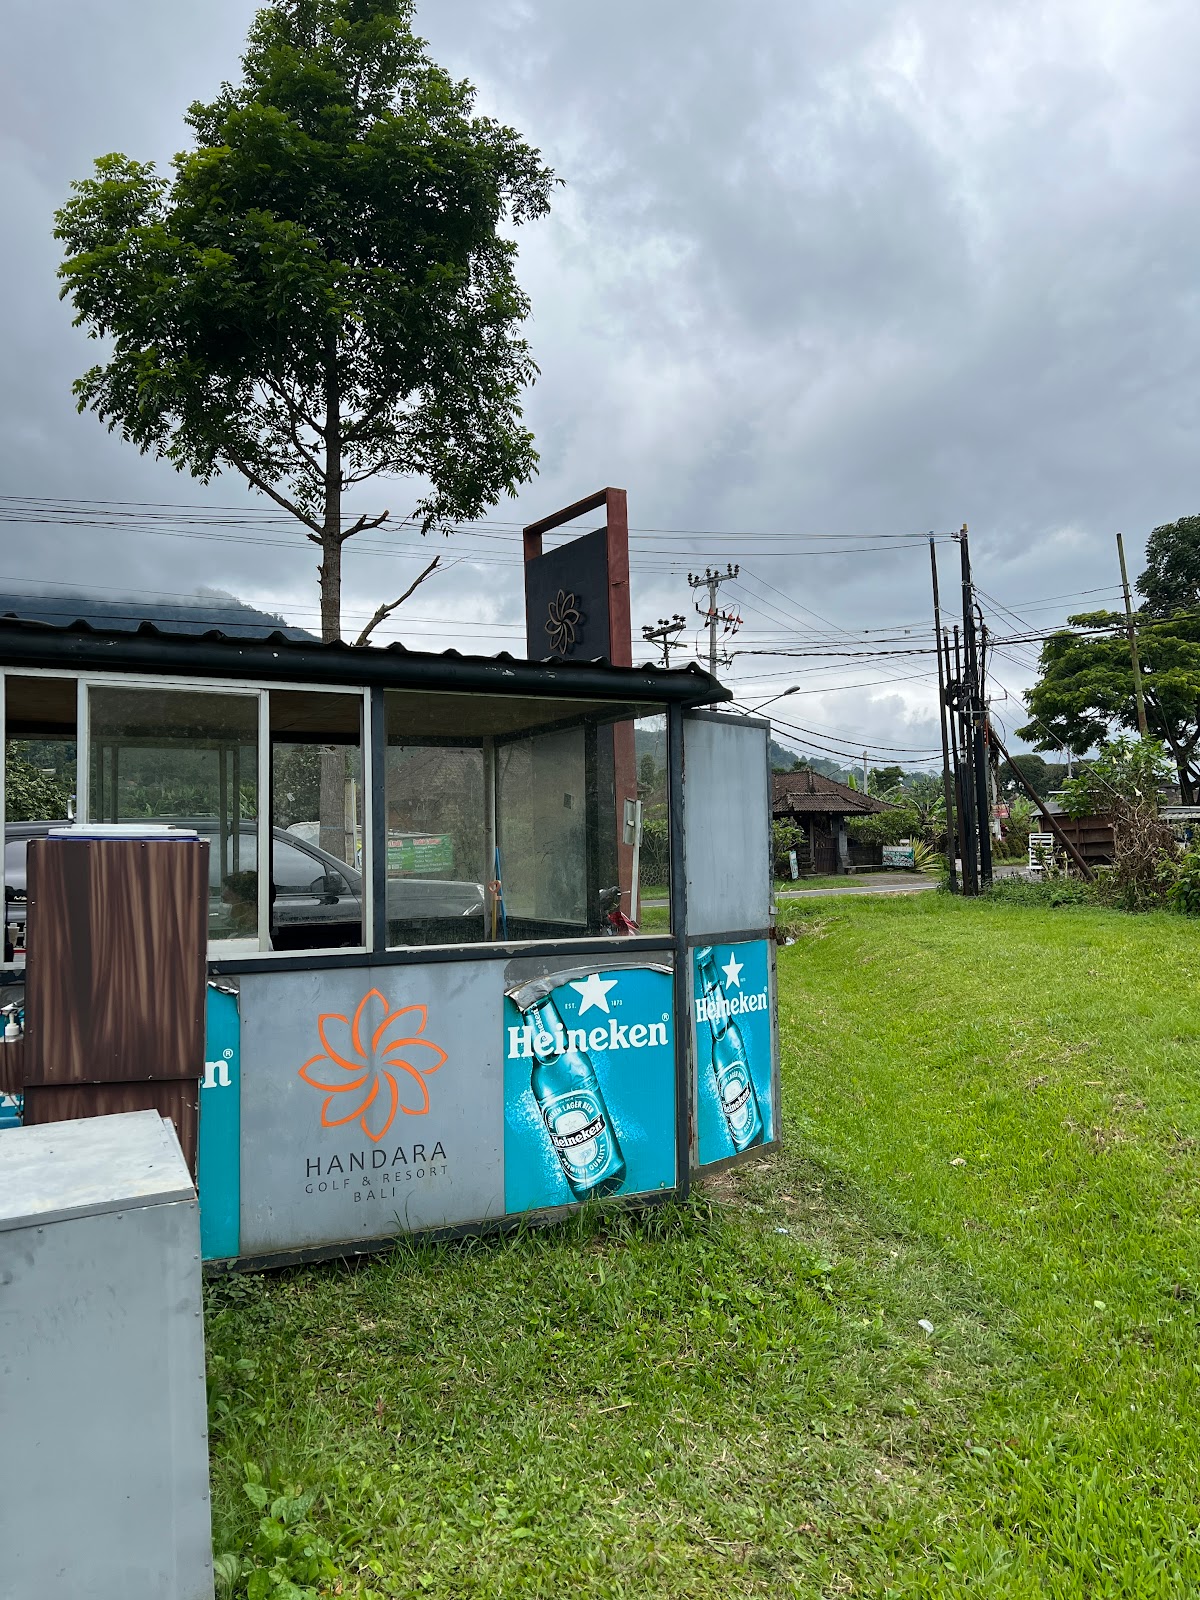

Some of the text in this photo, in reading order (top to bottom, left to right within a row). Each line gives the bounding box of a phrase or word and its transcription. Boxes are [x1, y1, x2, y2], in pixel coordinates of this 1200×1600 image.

[695, 991, 768, 1023] Heineken
[508, 1018, 668, 1059] Heineken
[552, 1120, 603, 1147] Heineken
[306, 1141, 447, 1177] HANDARA
[305, 1165, 448, 1194] GOLF & RESORT
[353, 1187, 396, 1203] BALI
